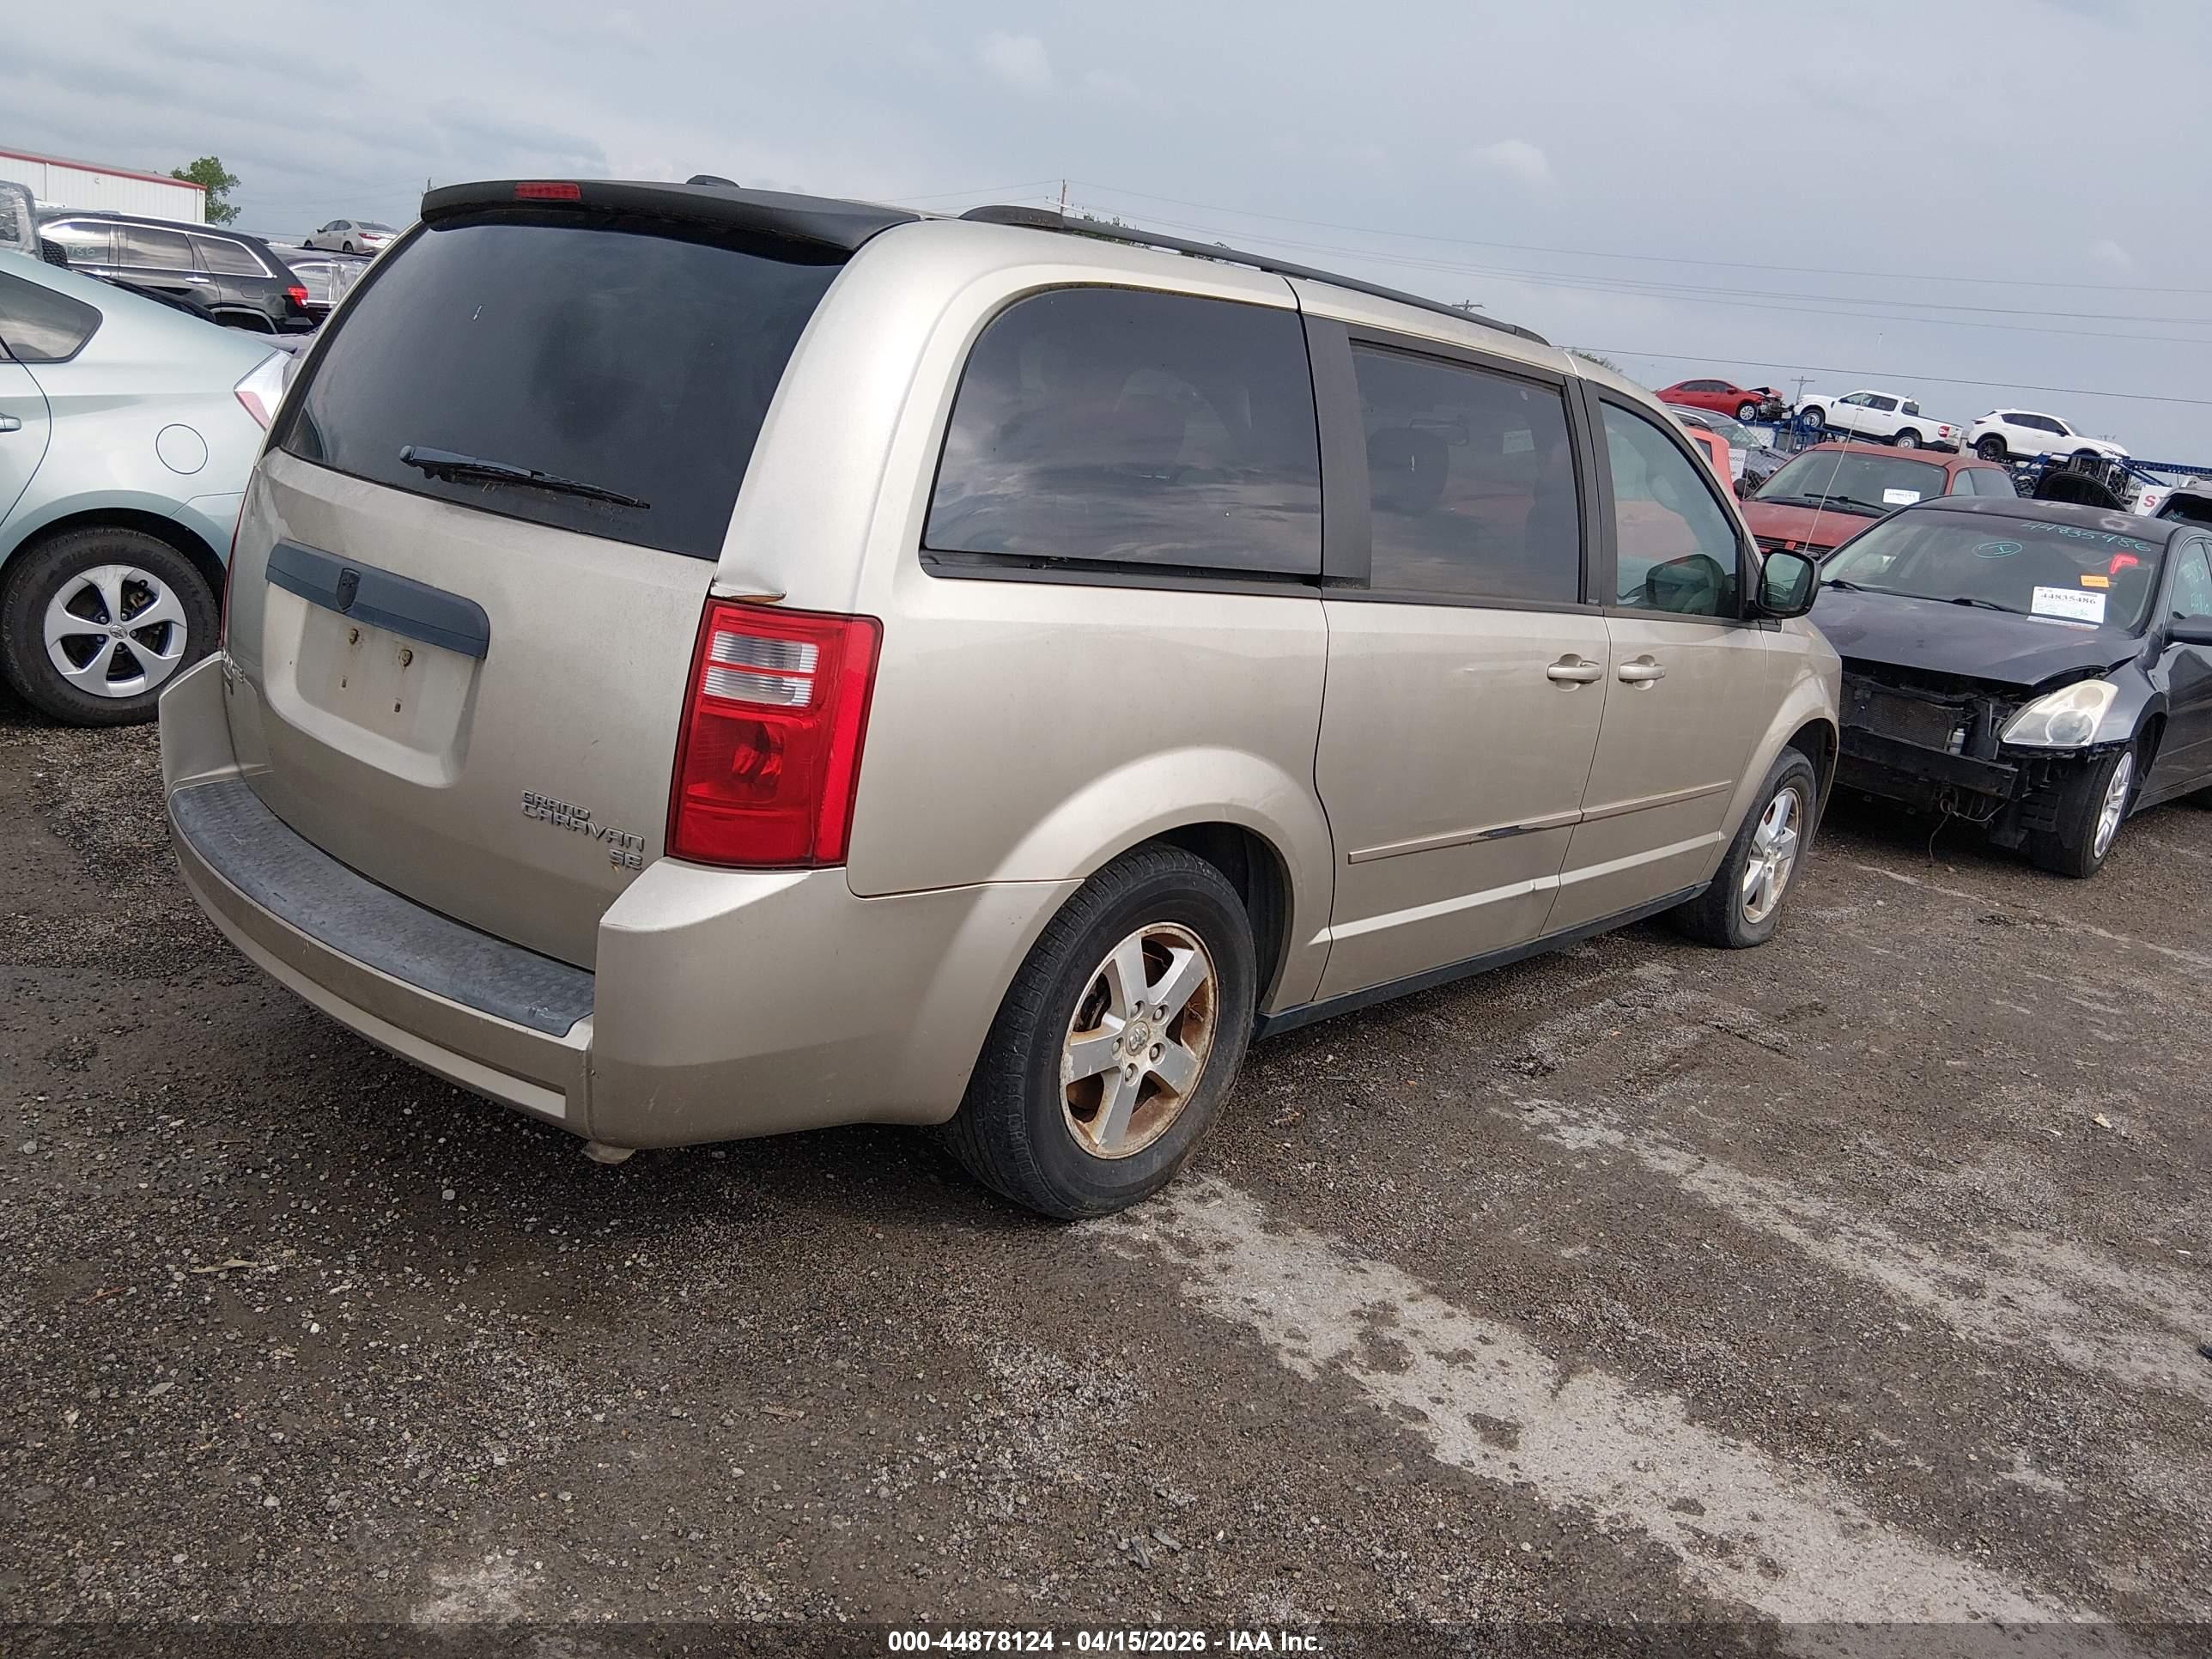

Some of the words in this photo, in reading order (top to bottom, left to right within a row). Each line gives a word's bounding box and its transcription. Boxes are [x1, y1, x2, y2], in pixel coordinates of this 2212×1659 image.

[2020, 521, 2152, 552] 44835486
[521, 789, 591, 820] GRAND
[521, 802, 645, 853] CARAVAN
[609, 848, 643, 871] SE
